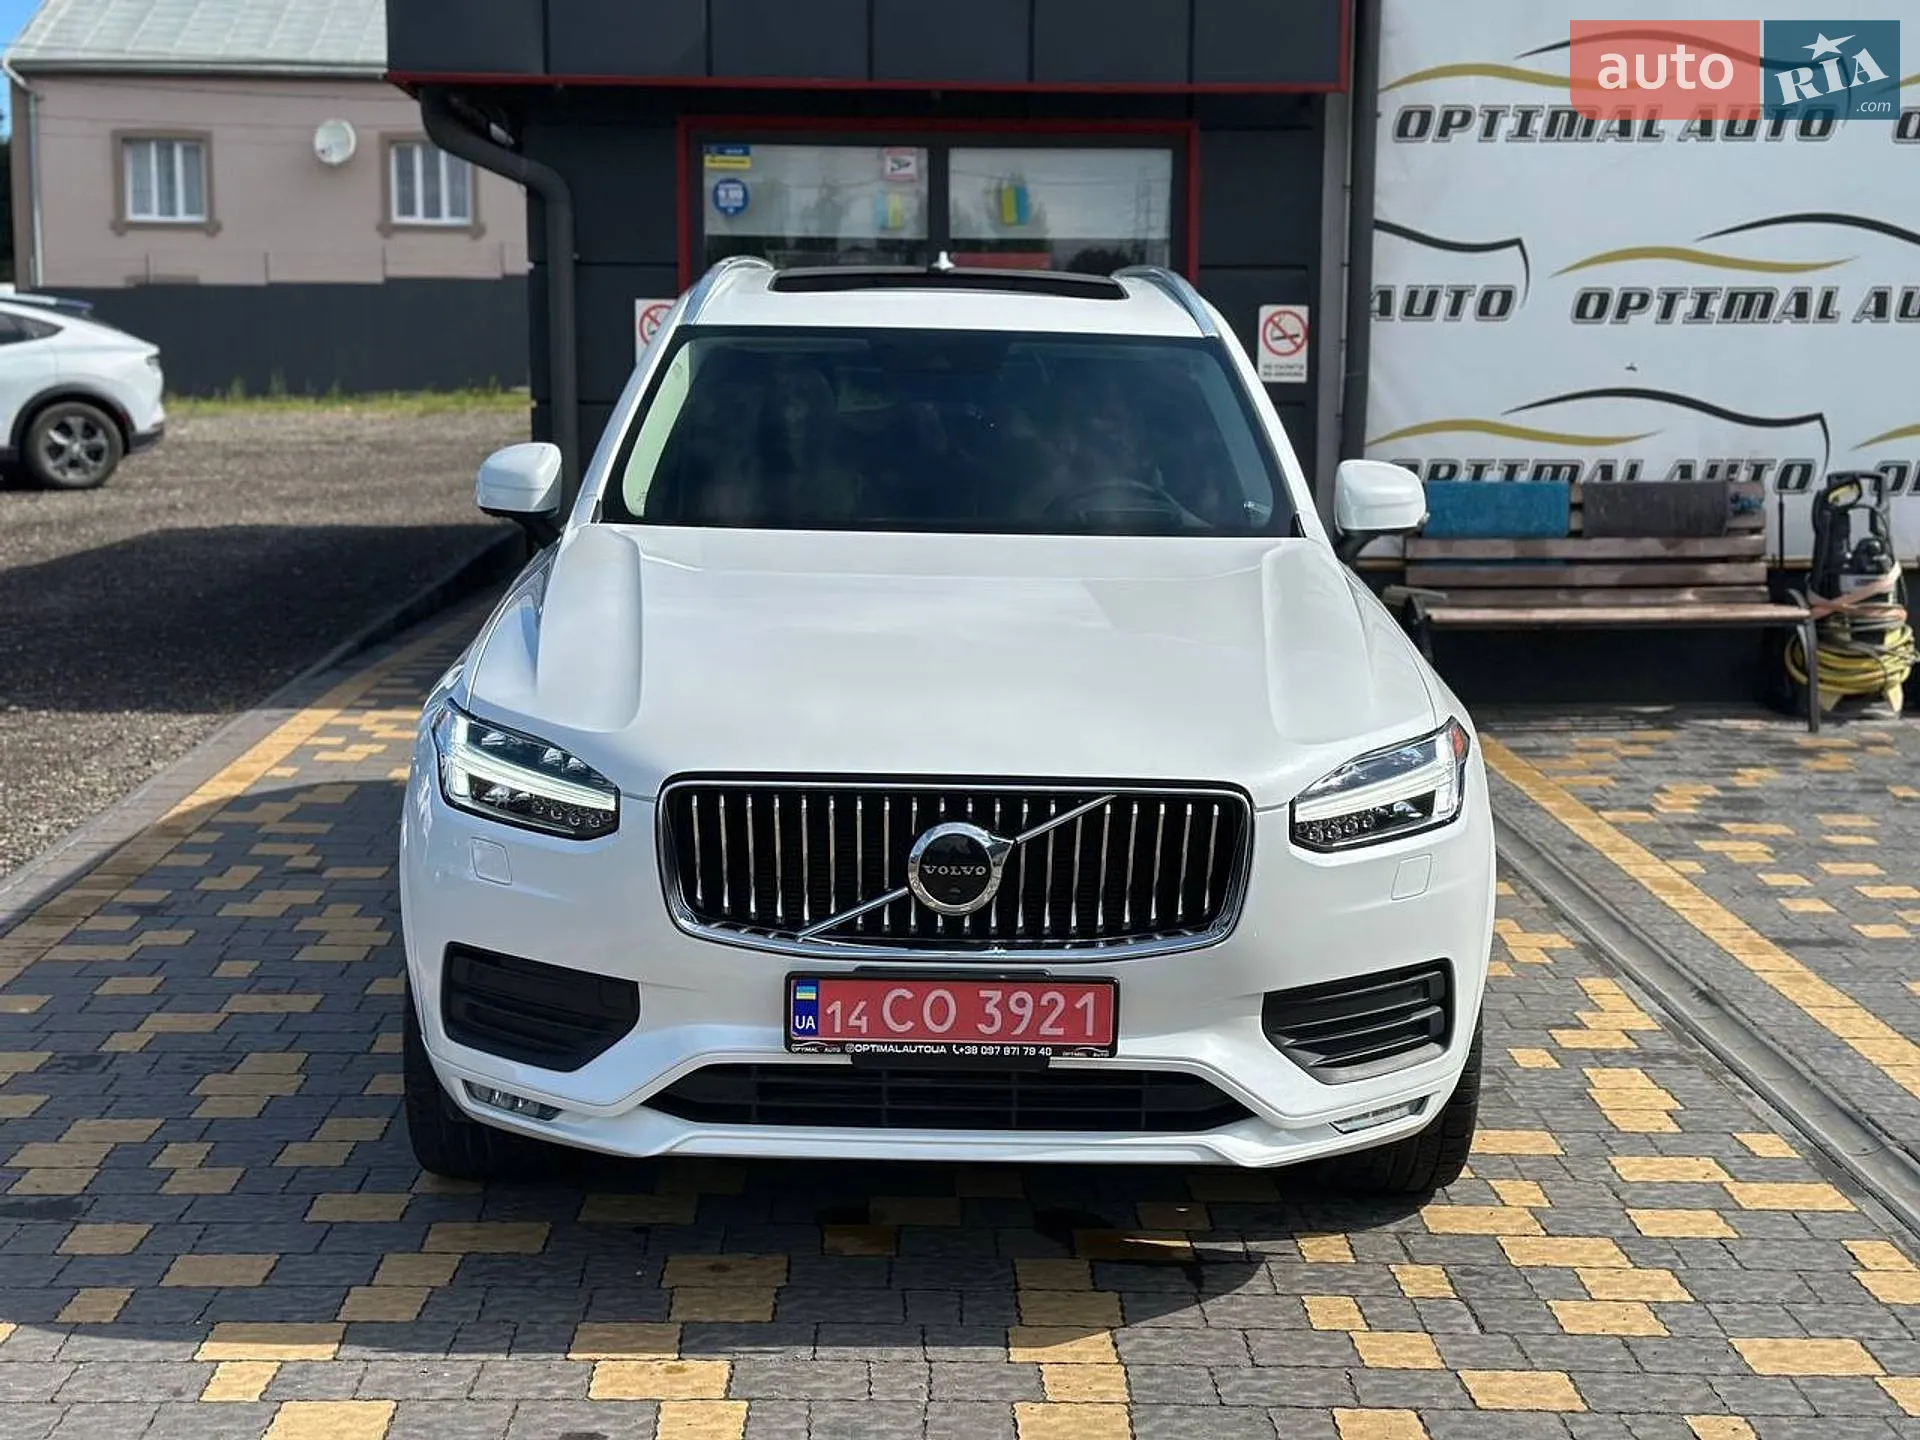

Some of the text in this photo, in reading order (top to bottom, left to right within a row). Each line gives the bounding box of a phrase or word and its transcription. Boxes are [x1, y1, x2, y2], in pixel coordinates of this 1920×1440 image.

[1393, 104, 1838, 143] OPTIMAL AUTO
[1570, 286, 1840, 324] OPTIMAL
[922, 865, 986, 876] VOLVO
[795, 1015, 816, 1030] UA
[825, 988, 1096, 1037] 14 CO 3921
[1038, 1046, 1053, 1056] 40
